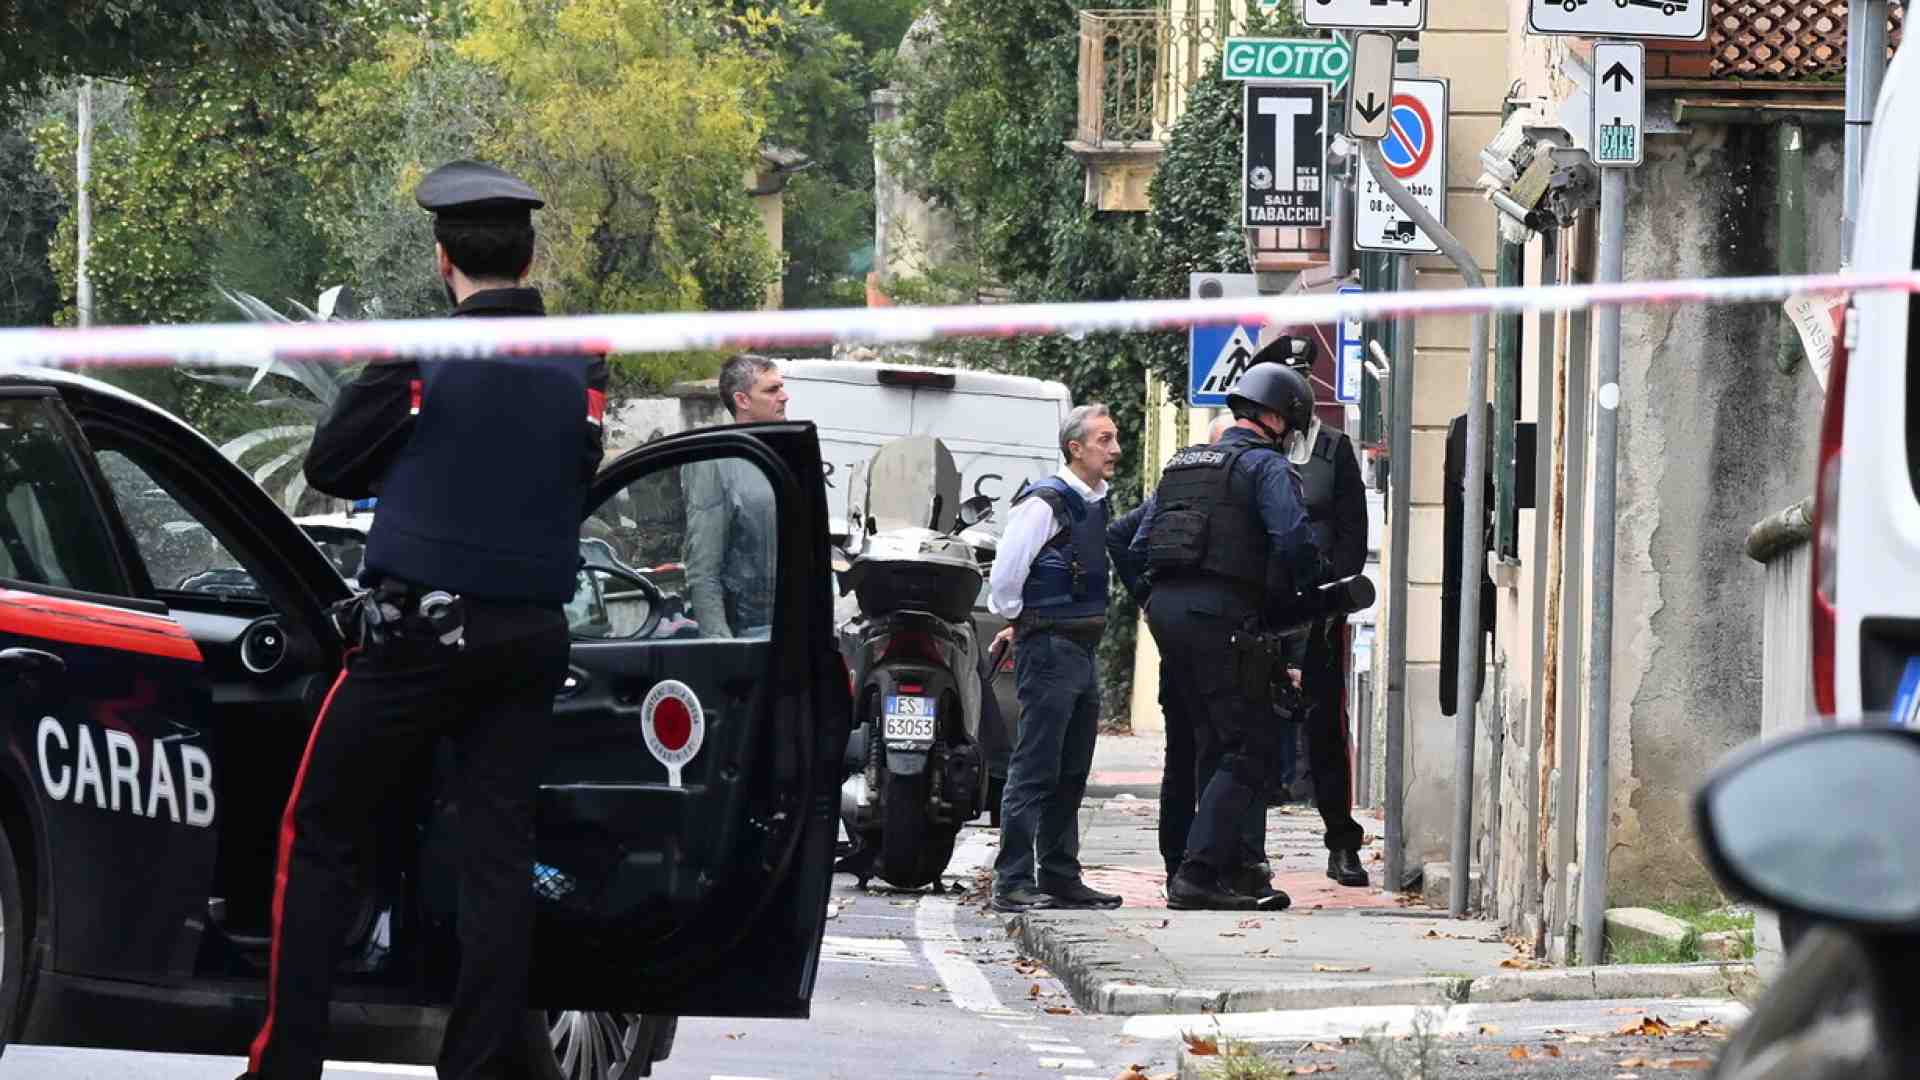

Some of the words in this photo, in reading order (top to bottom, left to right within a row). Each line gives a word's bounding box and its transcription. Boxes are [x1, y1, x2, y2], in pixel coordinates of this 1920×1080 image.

[1229, 44, 1349, 76] GIOTTO
[1257, 96, 1312, 192] T
[1264, 194, 1292, 206] SALI
[1296, 194, 1304, 206] E
[1248, 205, 1320, 222] TABACCHI
[897, 698, 916, 714] ES
[887, 718, 932, 736] 63053
[37, 716, 216, 828] CARAB
